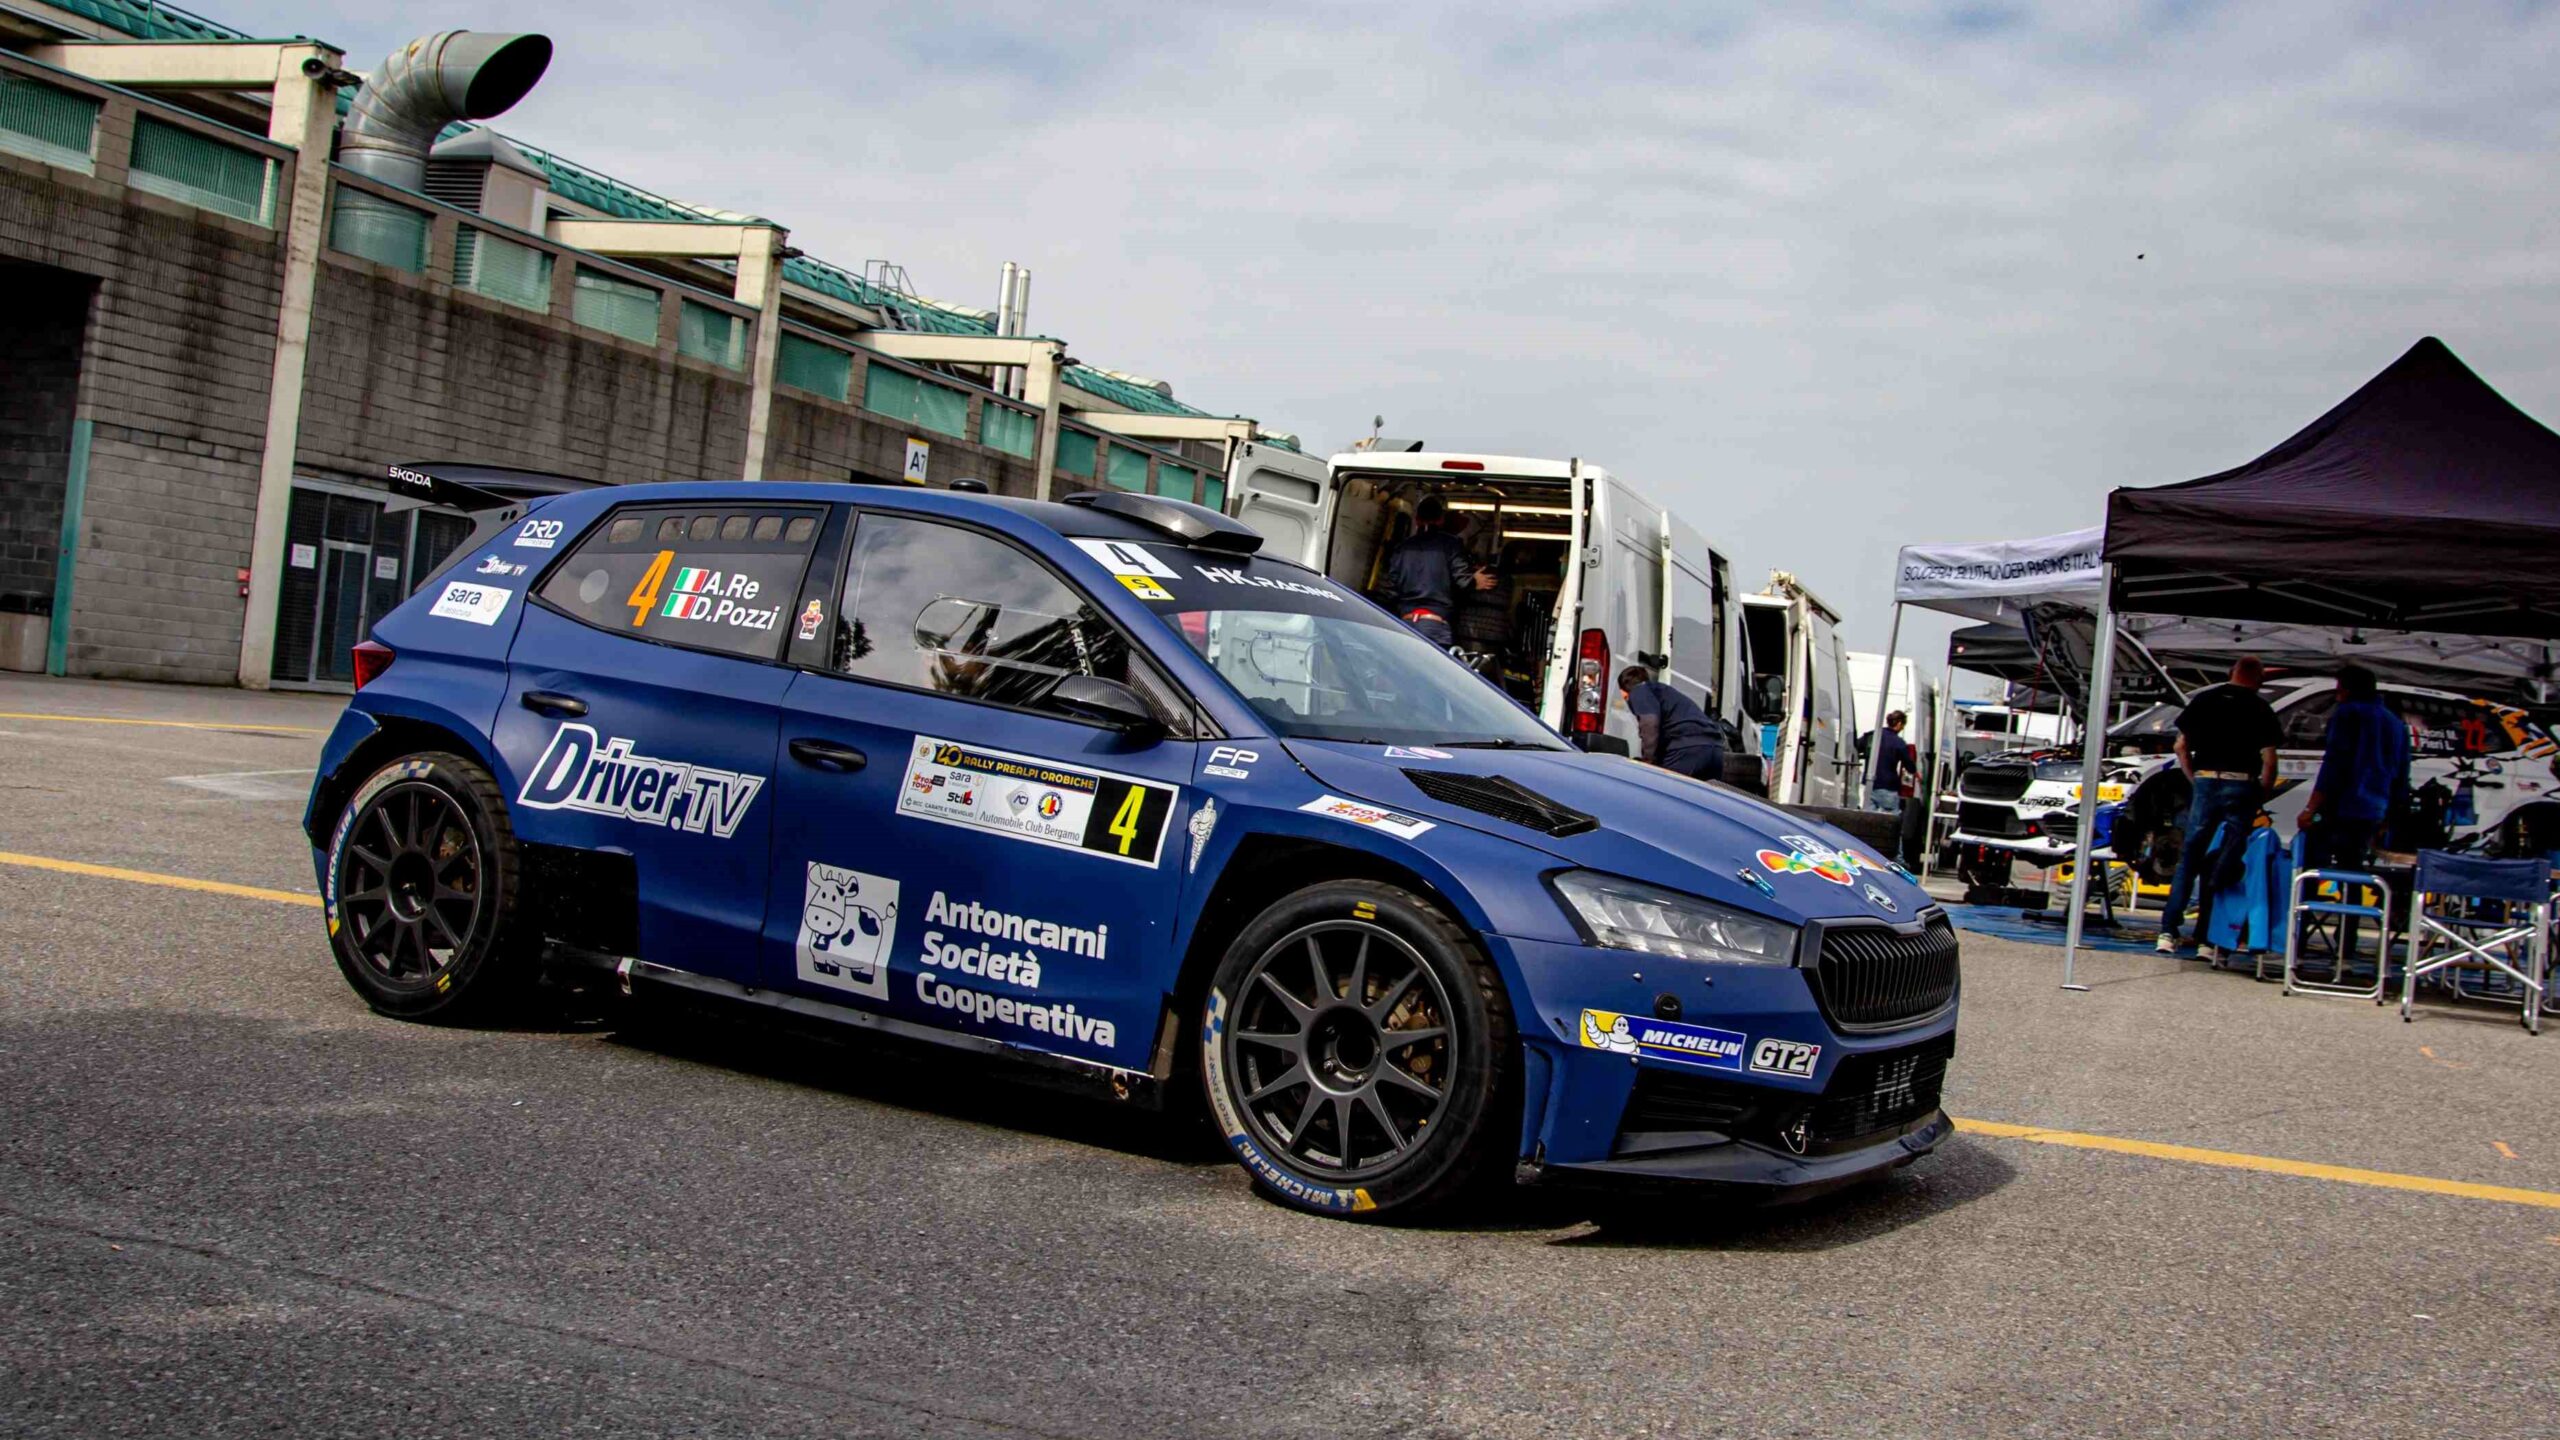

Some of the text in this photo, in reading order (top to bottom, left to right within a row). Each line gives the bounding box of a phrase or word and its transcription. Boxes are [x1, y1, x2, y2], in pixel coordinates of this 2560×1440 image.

[519, 520, 563, 538] DRD
[1104, 543, 1154, 574] 4
[2027, 556, 2070, 577] RACING
[627, 550, 675, 627] 4
[702, 571, 759, 599] A.Re
[1193, 566, 1260, 586] HK
[447, 588, 482, 606] sara
[690, 598, 780, 630] D.Pozzi
[936, 744, 1095, 790] 40 RALLY PREALPI OROBICHE
[1208, 746, 1260, 766] FP
[949, 771, 971, 783] sara
[980, 811, 1080, 843] Automobile Club Bergamo
[1108, 785, 1146, 855] 4
[925, 891, 1107, 960] Antoncarni
[920, 931, 1041, 988] Società
[916, 972, 1115, 1047] Cooperativa
[1641, 1028, 1742, 1056] MICHELIN
[1754, 1040, 1821, 1074] GT2i
[1238, 1141, 1334, 1206] MICHELIN
